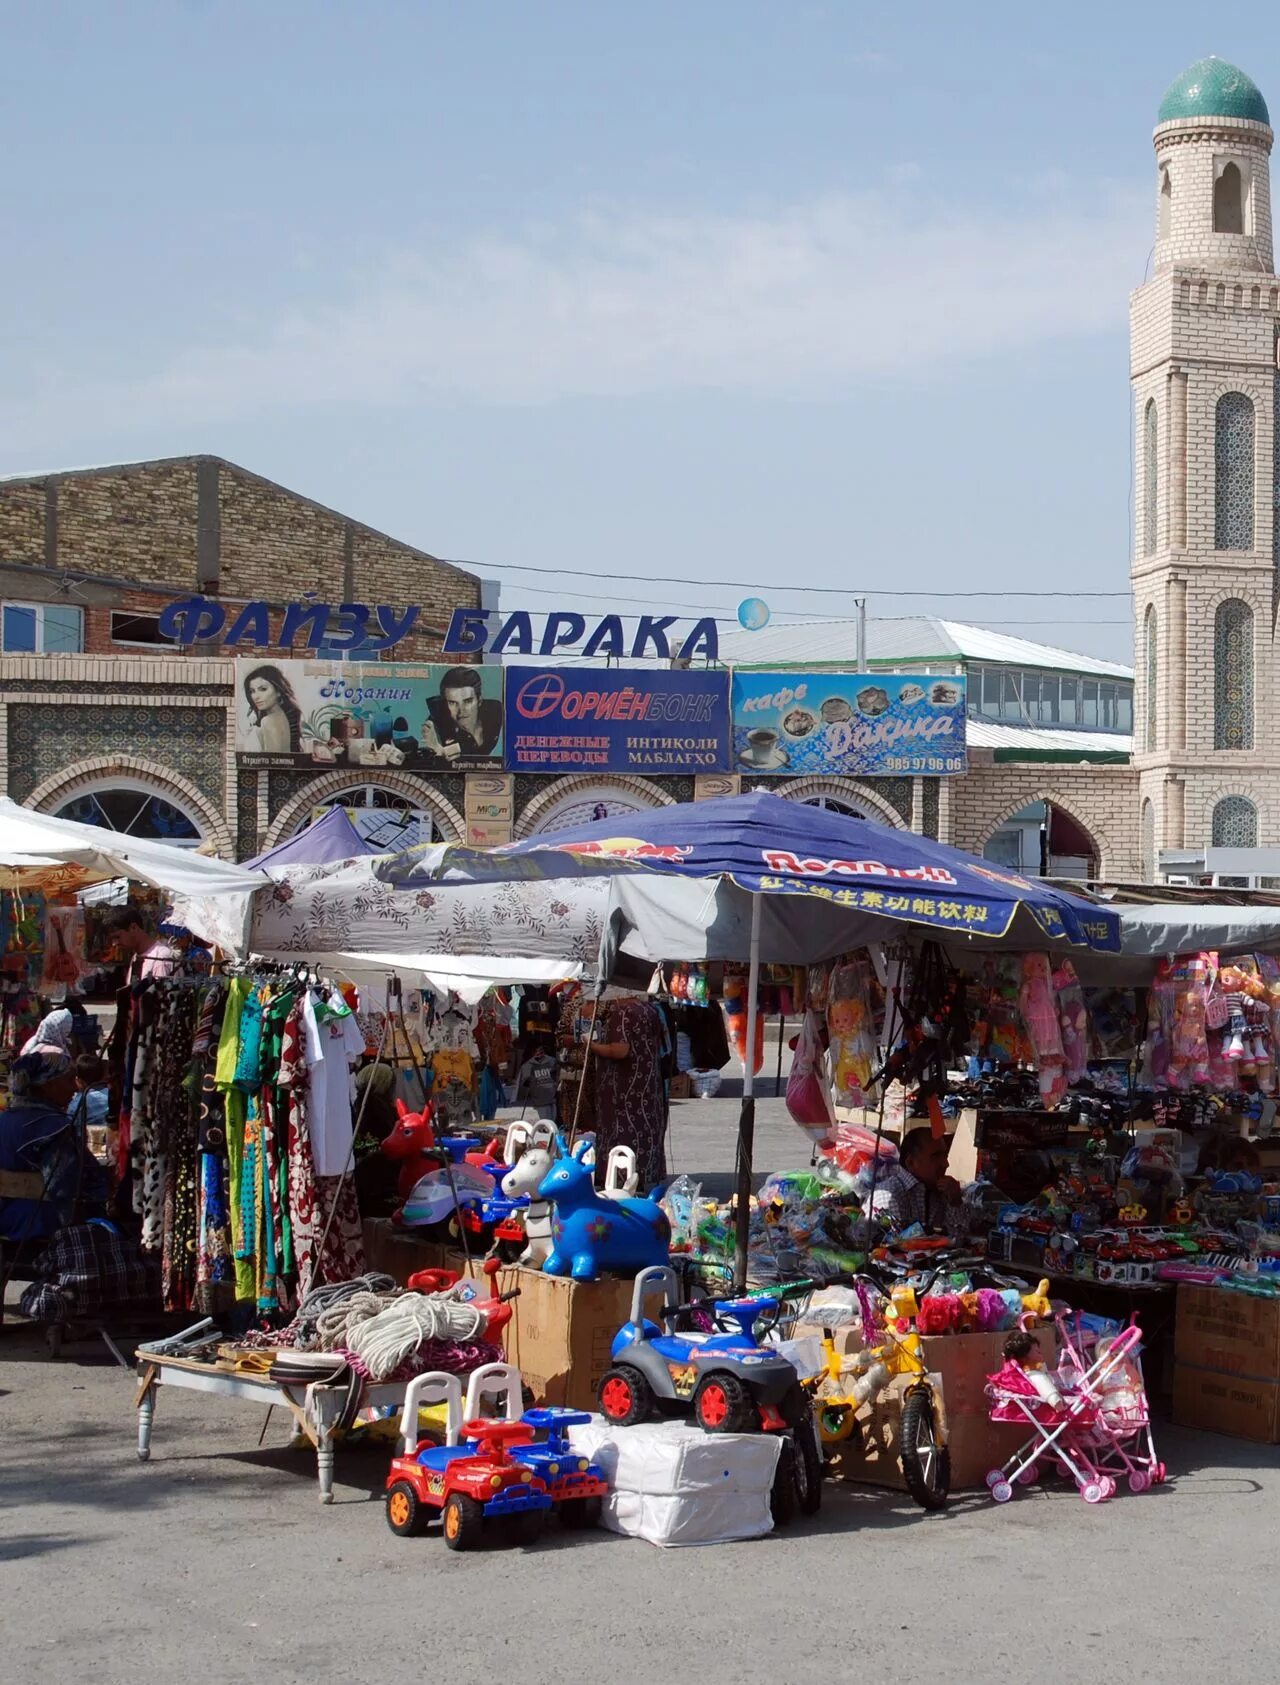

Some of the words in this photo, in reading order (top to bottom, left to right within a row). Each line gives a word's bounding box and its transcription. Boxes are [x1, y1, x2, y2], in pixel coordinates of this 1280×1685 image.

[159, 592, 421, 650] ФАЙЗУ
[442, 609, 718, 659] БАРАКА
[320, 680, 413, 704] Нозанин
[743, 684, 807, 712] кафе
[514, 735, 610, 748] ДЕНЕЖНЫЕ
[627, 737, 718, 751] ИНТИҚОЛИ
[517, 751, 609, 765] ПЕРЕВОДЫ
[886, 758, 910, 770] 985
[912, 758, 926, 770] 97
[929, 758, 943, 770] 96
[947, 758, 961, 770] 06
